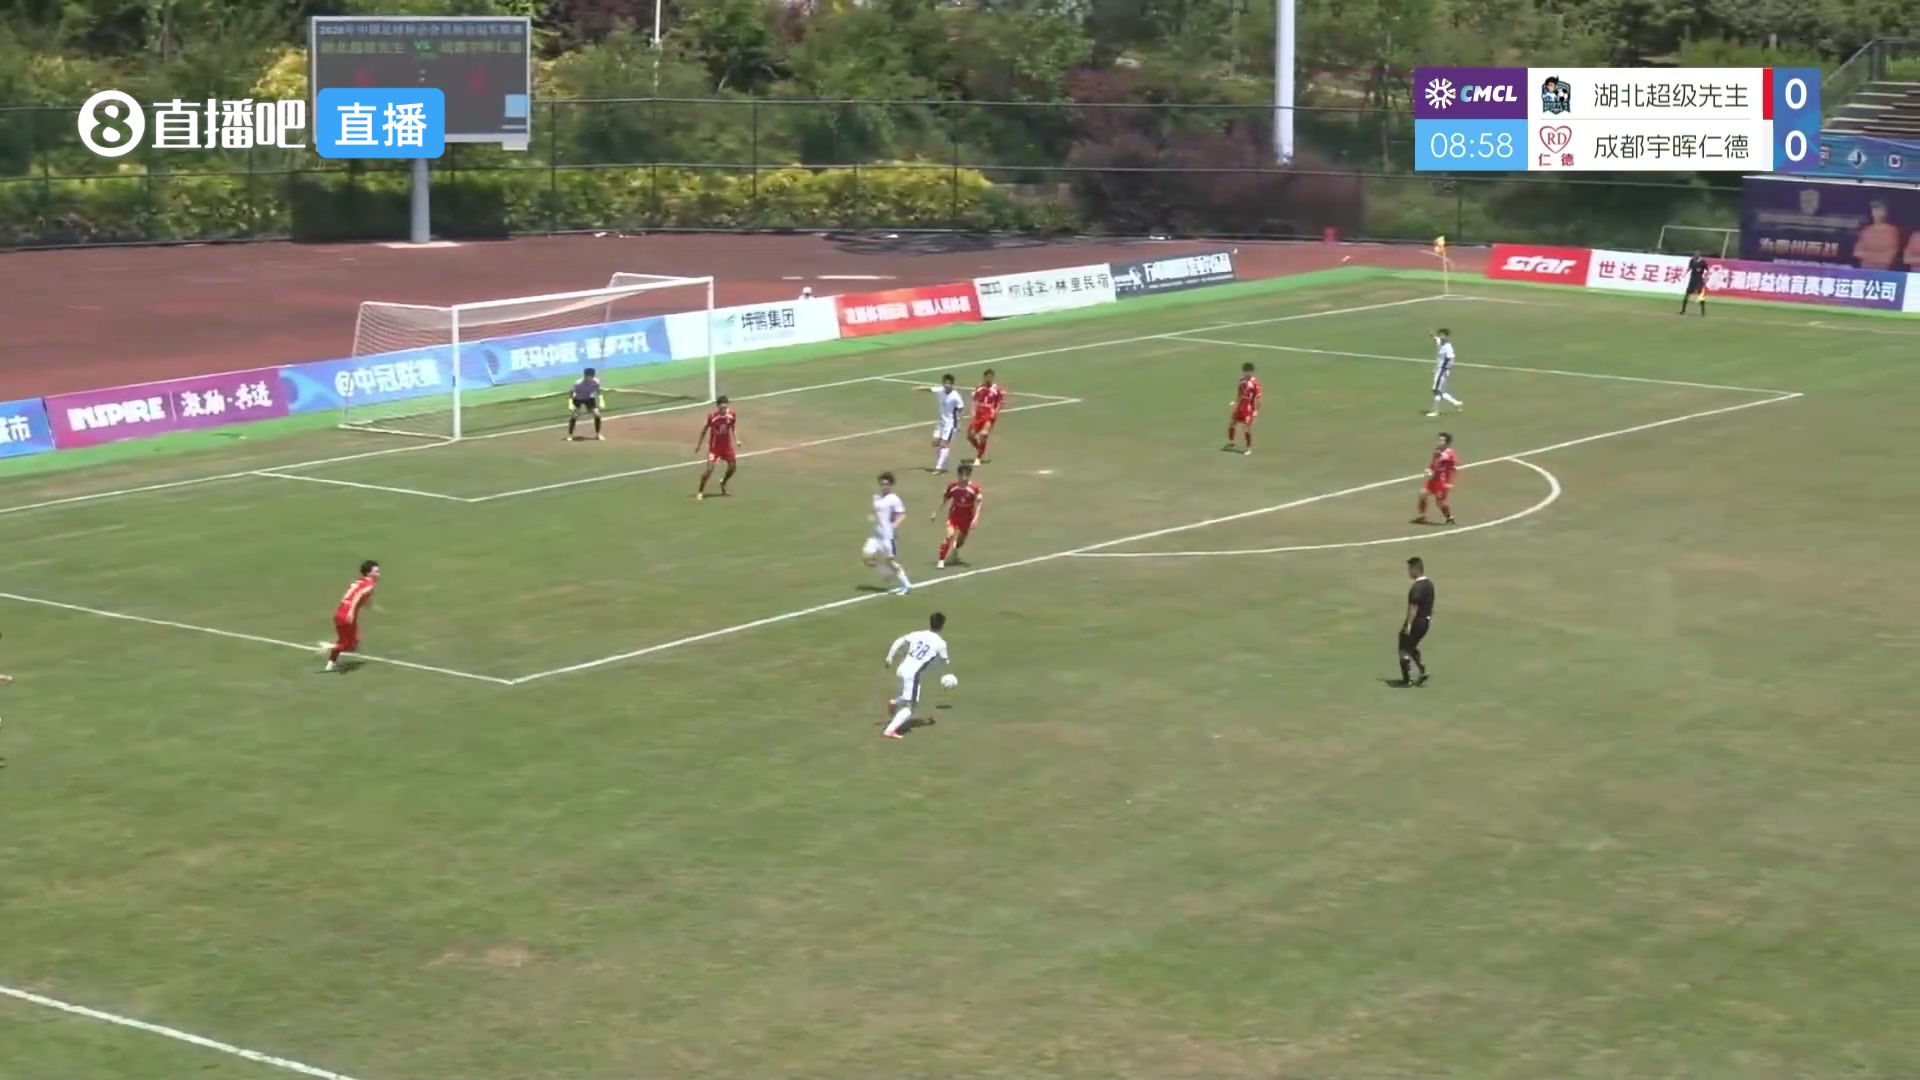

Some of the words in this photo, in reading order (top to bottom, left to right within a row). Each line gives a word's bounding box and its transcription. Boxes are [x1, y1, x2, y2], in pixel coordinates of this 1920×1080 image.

[1598, 260, 1686, 285] 世达足球
[66, 396, 166, 432] INSPIRE
[909, 640, 930, 661] 28
